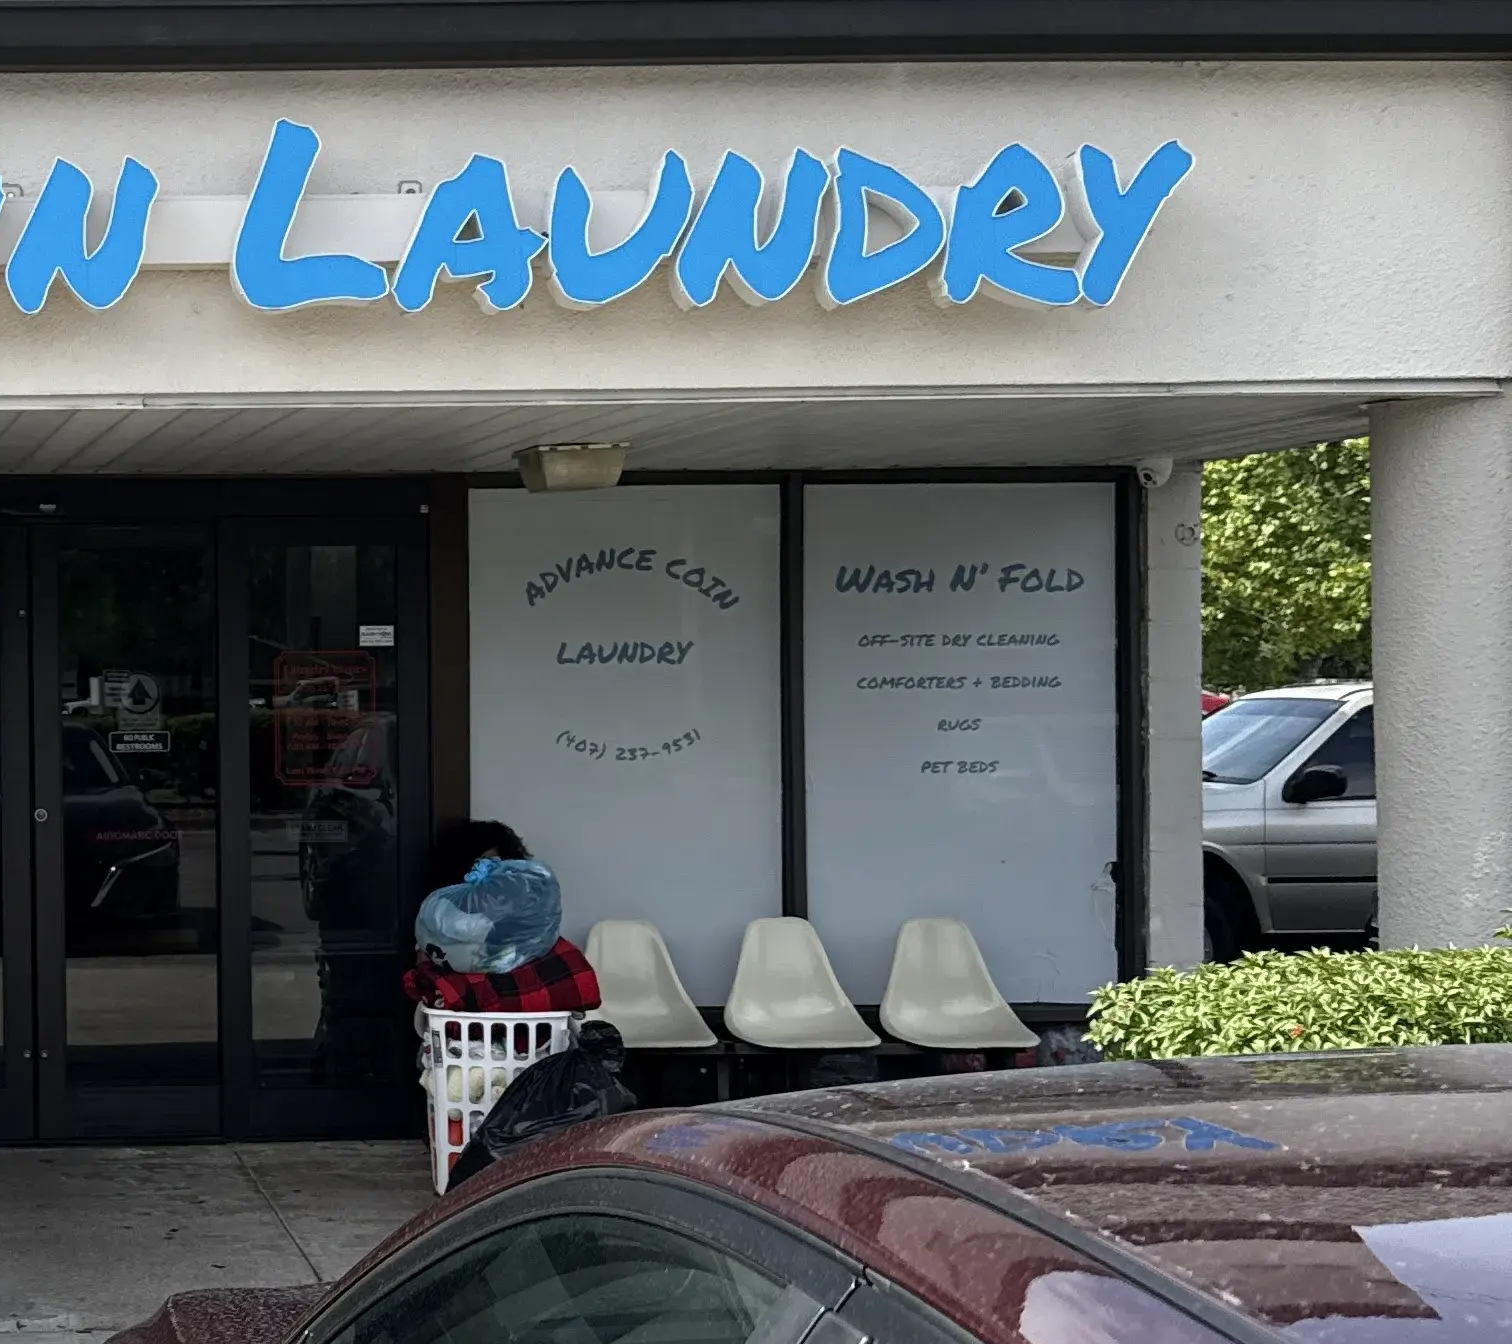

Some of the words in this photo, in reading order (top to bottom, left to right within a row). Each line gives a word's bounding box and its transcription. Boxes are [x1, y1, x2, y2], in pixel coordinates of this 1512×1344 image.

[230, 117, 1196, 313] LAUNDRY
[525, 547, 657, 606] ADVANCE
[665, 558, 740, 610] COIN
[835, 564, 935, 593] WASH
[950, 562, 988, 592] N'
[998, 563, 1085, 593] FOLD
[556, 640, 694, 665] LAUNDRY
[858, 633, 936, 647] OFF-SITE
[941, 633, 972, 647] DRY
[976, 633, 1060, 647] CLEANING
[856, 676, 967, 690] COMFORTERS
[990, 676, 1062, 689] BEDDING
[937, 718, 982, 732] RUGS
[556, 730, 606, 760] (407)
[615, 728, 701, 761] 237-9531
[921, 761, 953, 774] PET
[957, 761, 999, 774] BEDS
